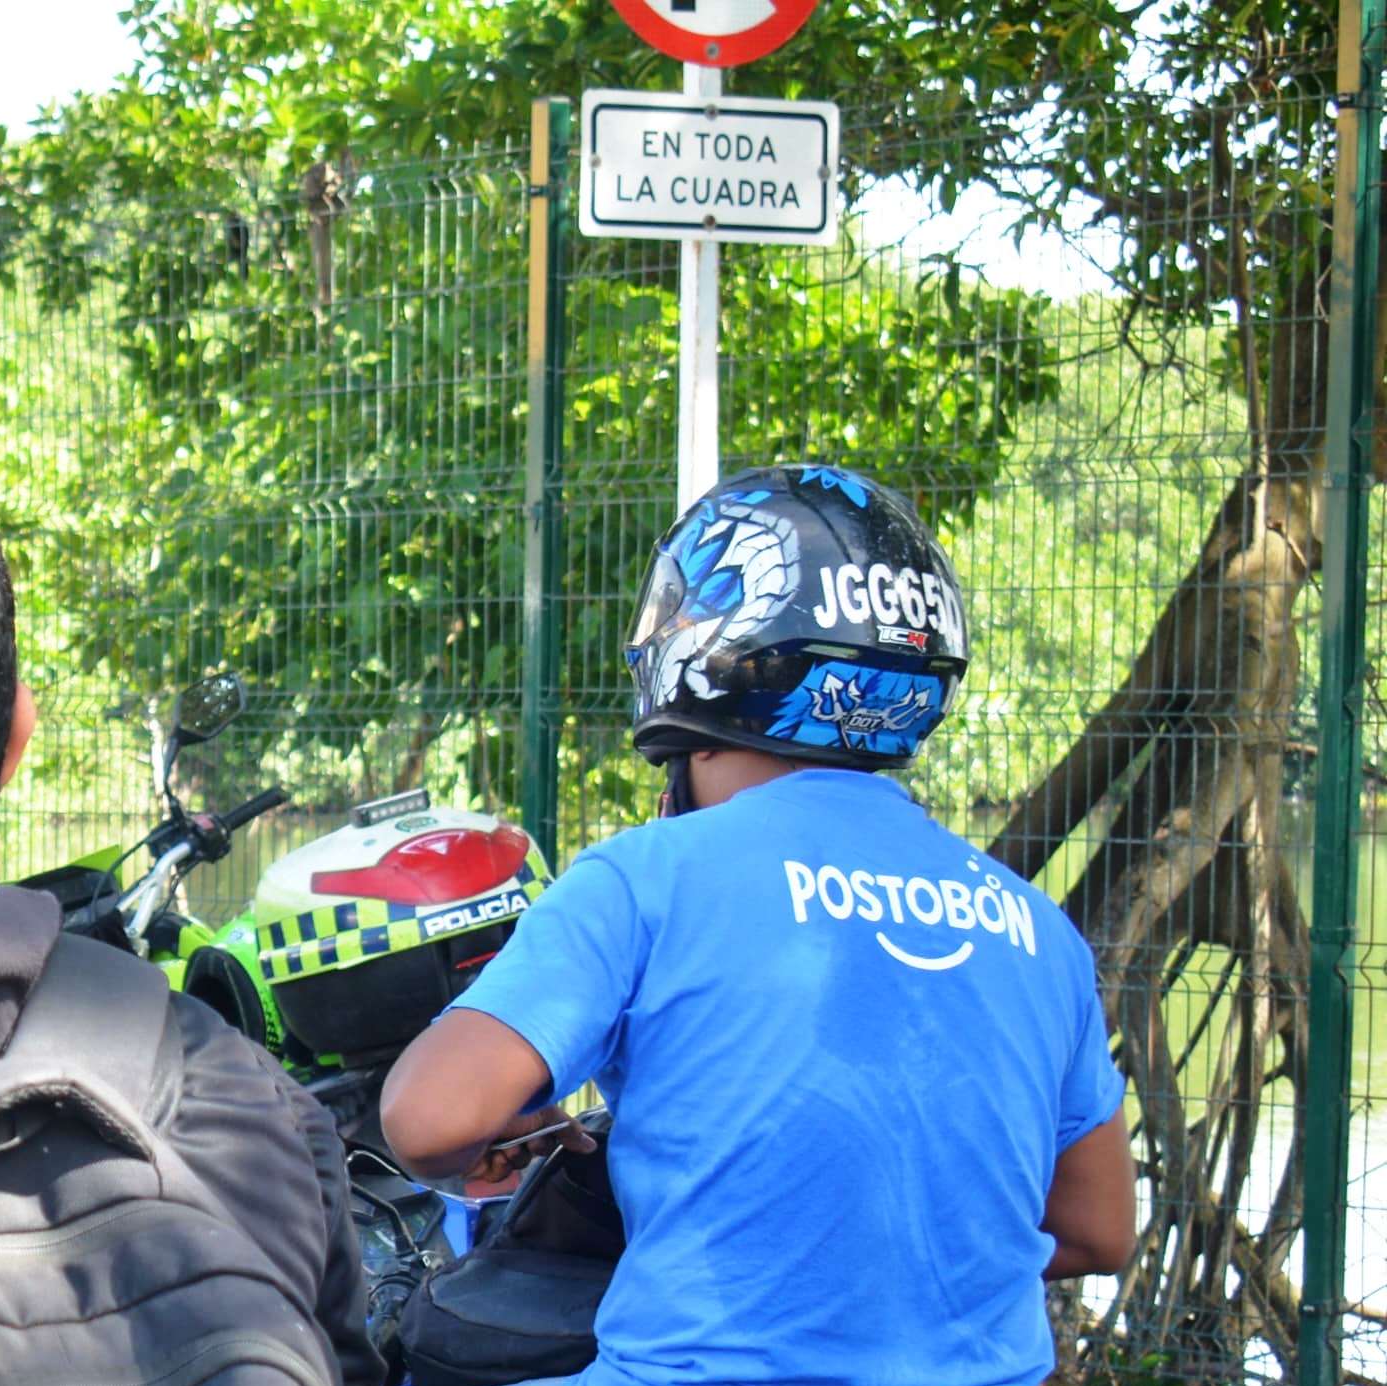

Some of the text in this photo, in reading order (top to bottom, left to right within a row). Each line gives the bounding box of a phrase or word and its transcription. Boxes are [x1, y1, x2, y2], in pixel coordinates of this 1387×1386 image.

[642, 131, 777, 163] EN TODA
[616, 174, 801, 209] LA CUADRA
[813, 563, 966, 659] JGG65D
[424, 893, 530, 937] POLICÍA
